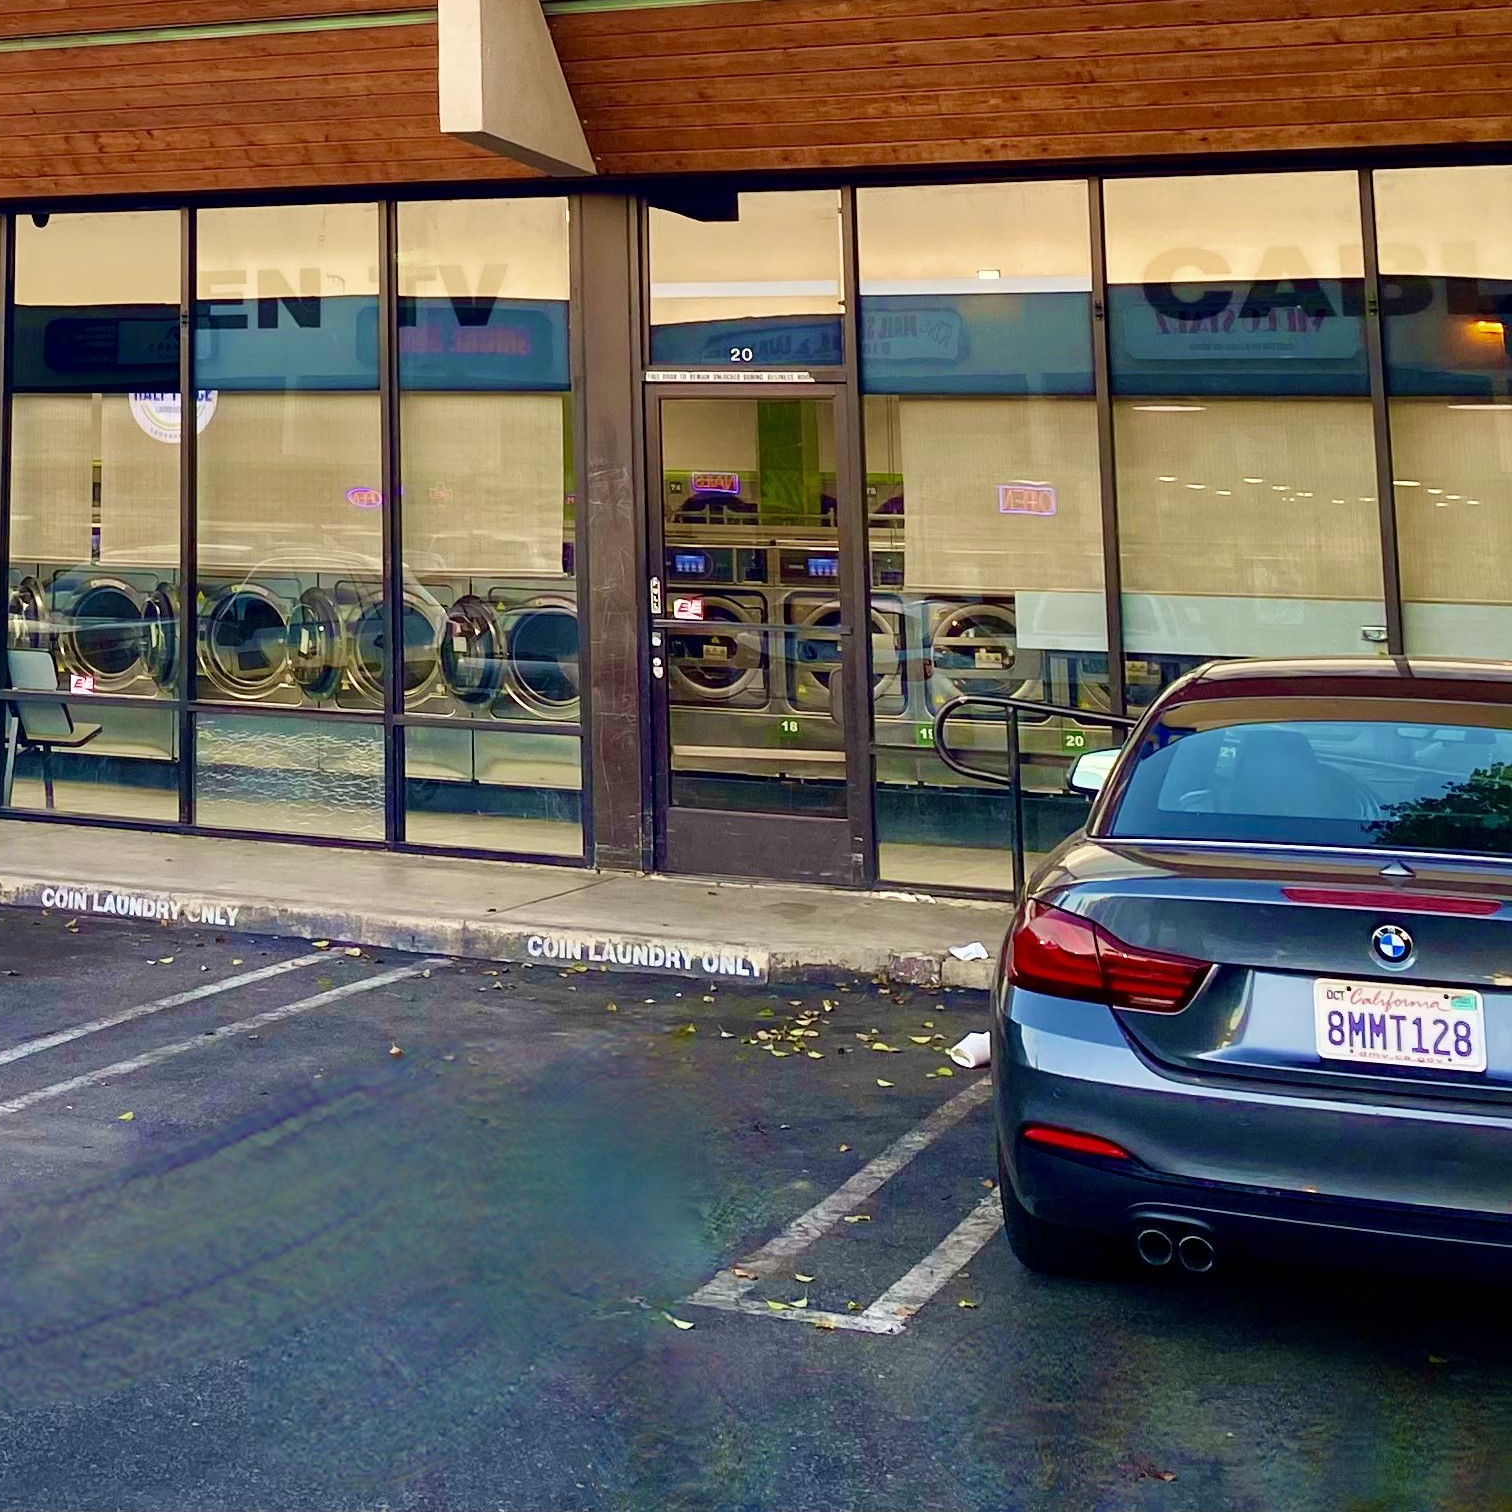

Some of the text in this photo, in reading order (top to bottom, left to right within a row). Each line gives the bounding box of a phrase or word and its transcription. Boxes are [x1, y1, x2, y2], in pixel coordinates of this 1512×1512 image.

[730, 348, 753, 362] 20
[782, 720, 799, 733] 18
[1066, 734, 1085, 747] 20
[41, 887, 239, 926] COIN LAUNDRY ONLY
[527, 935, 768, 978] COIN LAUNDRY ONLY
[1326, 990, 1345, 1001] OCT
[1350, 987, 1451, 1012] California
[1327, 1010, 1472, 1057] 8MMT128
[1358, 1050, 1444, 1065] dmv.ca.gov
